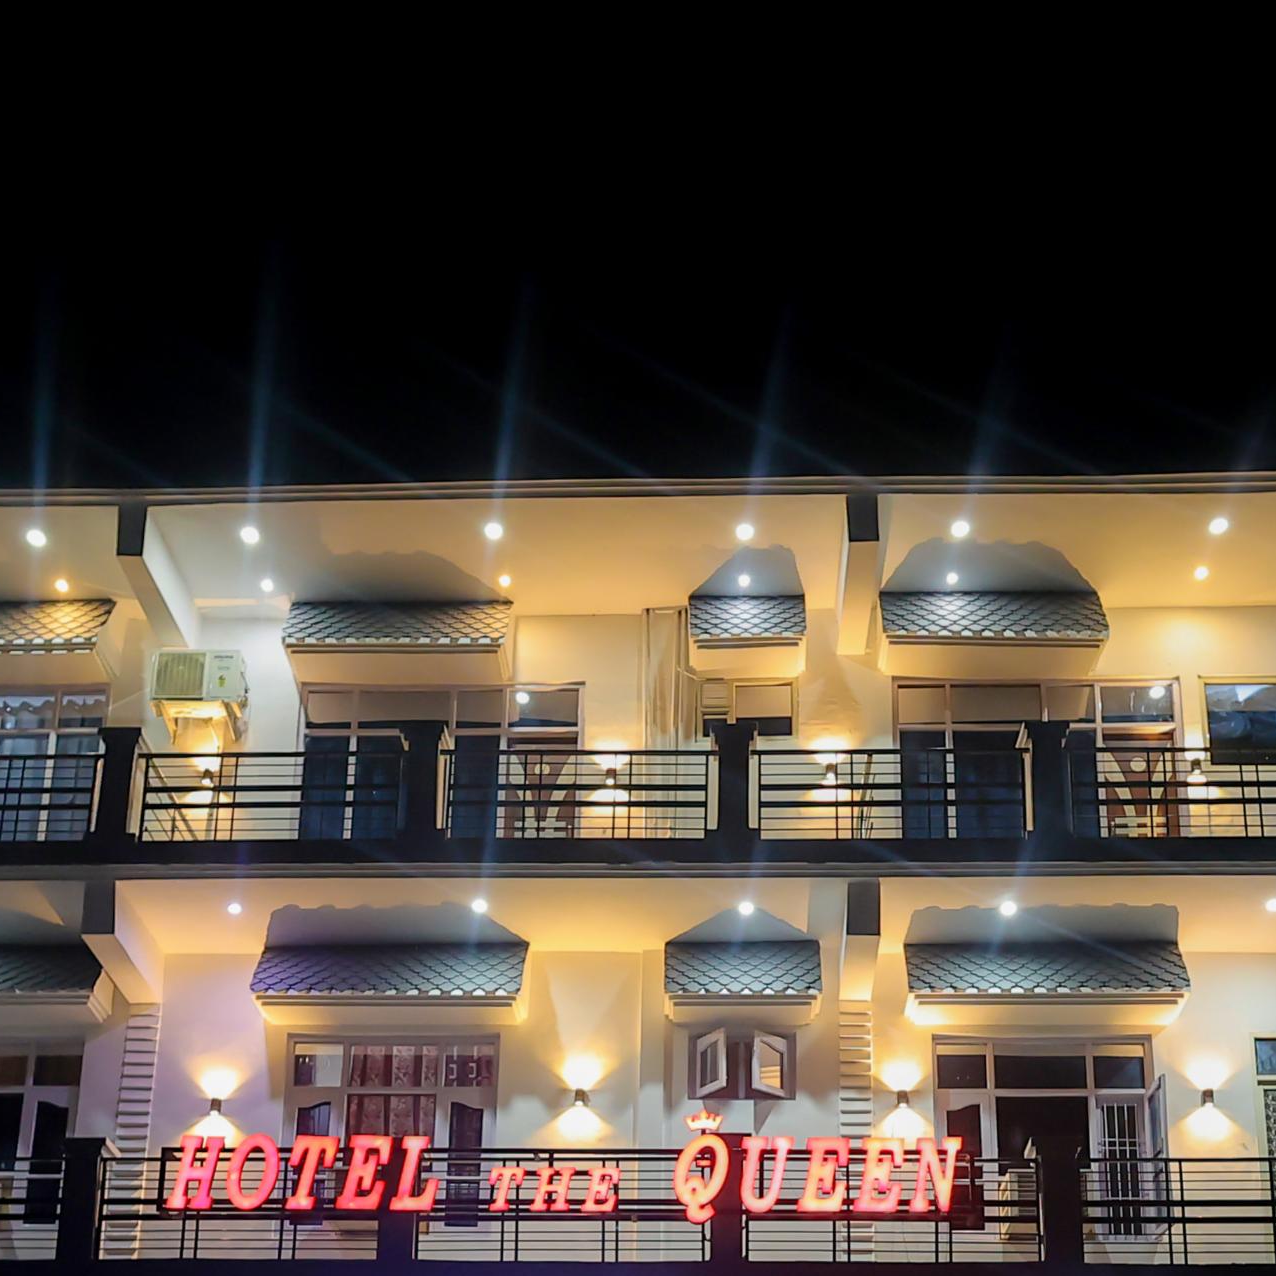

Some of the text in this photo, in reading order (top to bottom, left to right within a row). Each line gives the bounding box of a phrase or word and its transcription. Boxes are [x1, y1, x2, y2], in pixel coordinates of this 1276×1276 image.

[165, 1132, 964, 1225] HOTEL THE QUEEN
